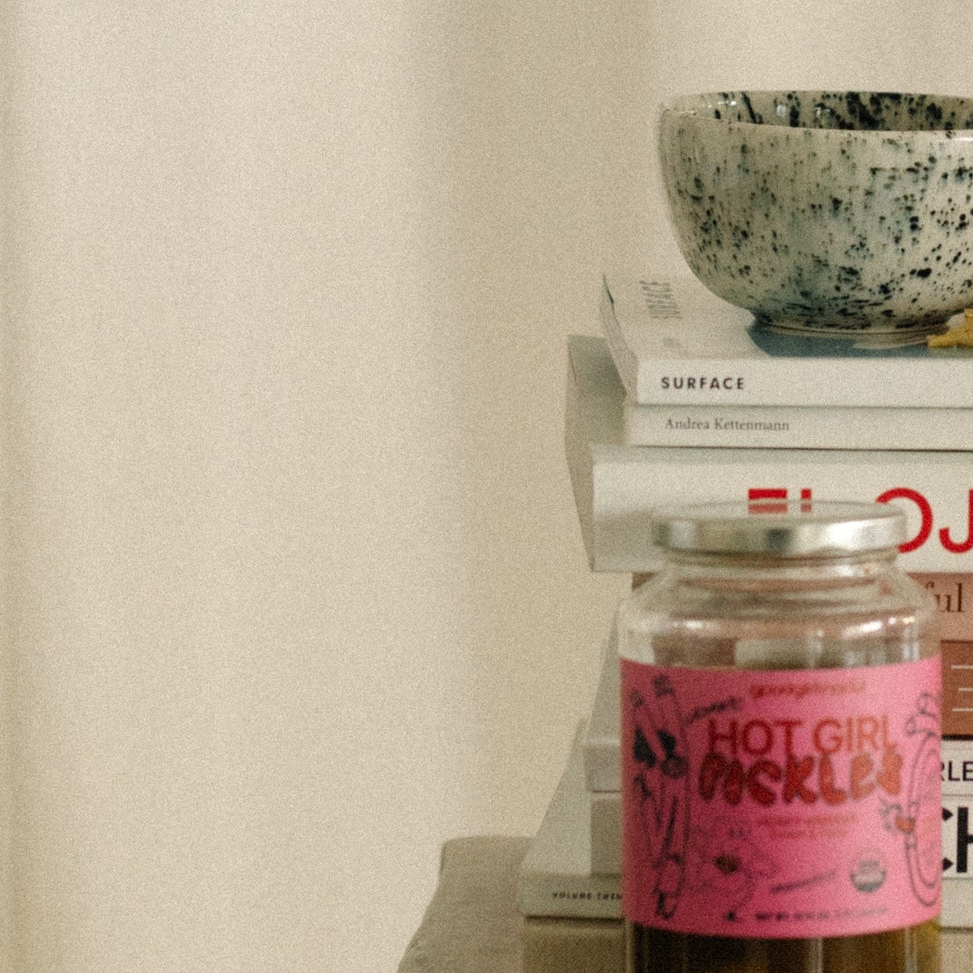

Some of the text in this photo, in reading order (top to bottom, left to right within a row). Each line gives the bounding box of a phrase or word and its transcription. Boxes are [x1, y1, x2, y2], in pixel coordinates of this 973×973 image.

[660, 376, 744, 391] SURFACE
[666, 416, 789, 431] Andrea Kettenmann
[707, 713, 898, 756] HOT GIRL
